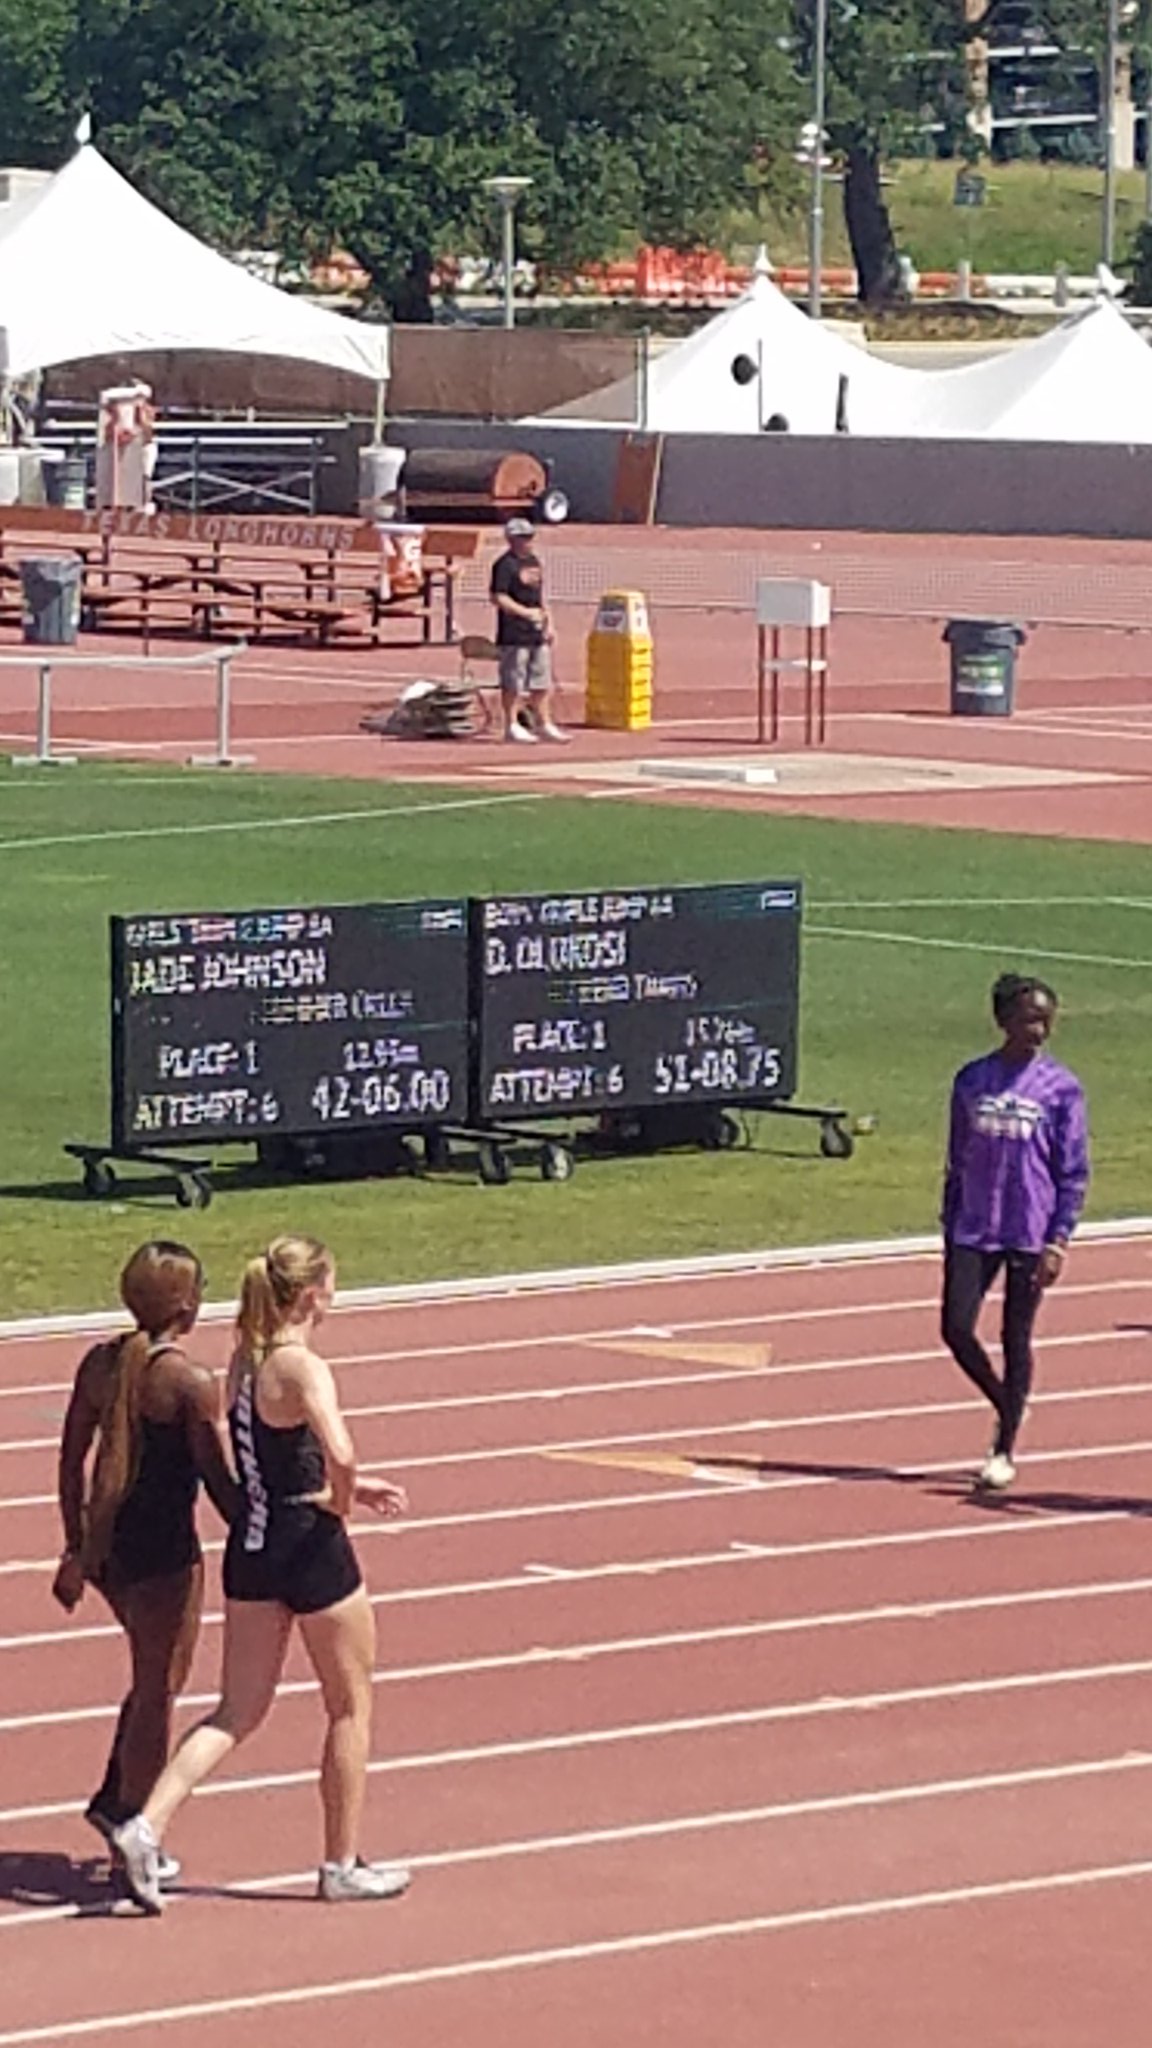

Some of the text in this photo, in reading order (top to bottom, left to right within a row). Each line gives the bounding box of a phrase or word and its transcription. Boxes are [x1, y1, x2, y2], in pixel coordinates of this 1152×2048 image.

[80, 509, 356, 549] TEXAS LONGHORNS
[202, 946, 328, 991] JOHNSON
[310, 1067, 451, 1122] 42-06.00
